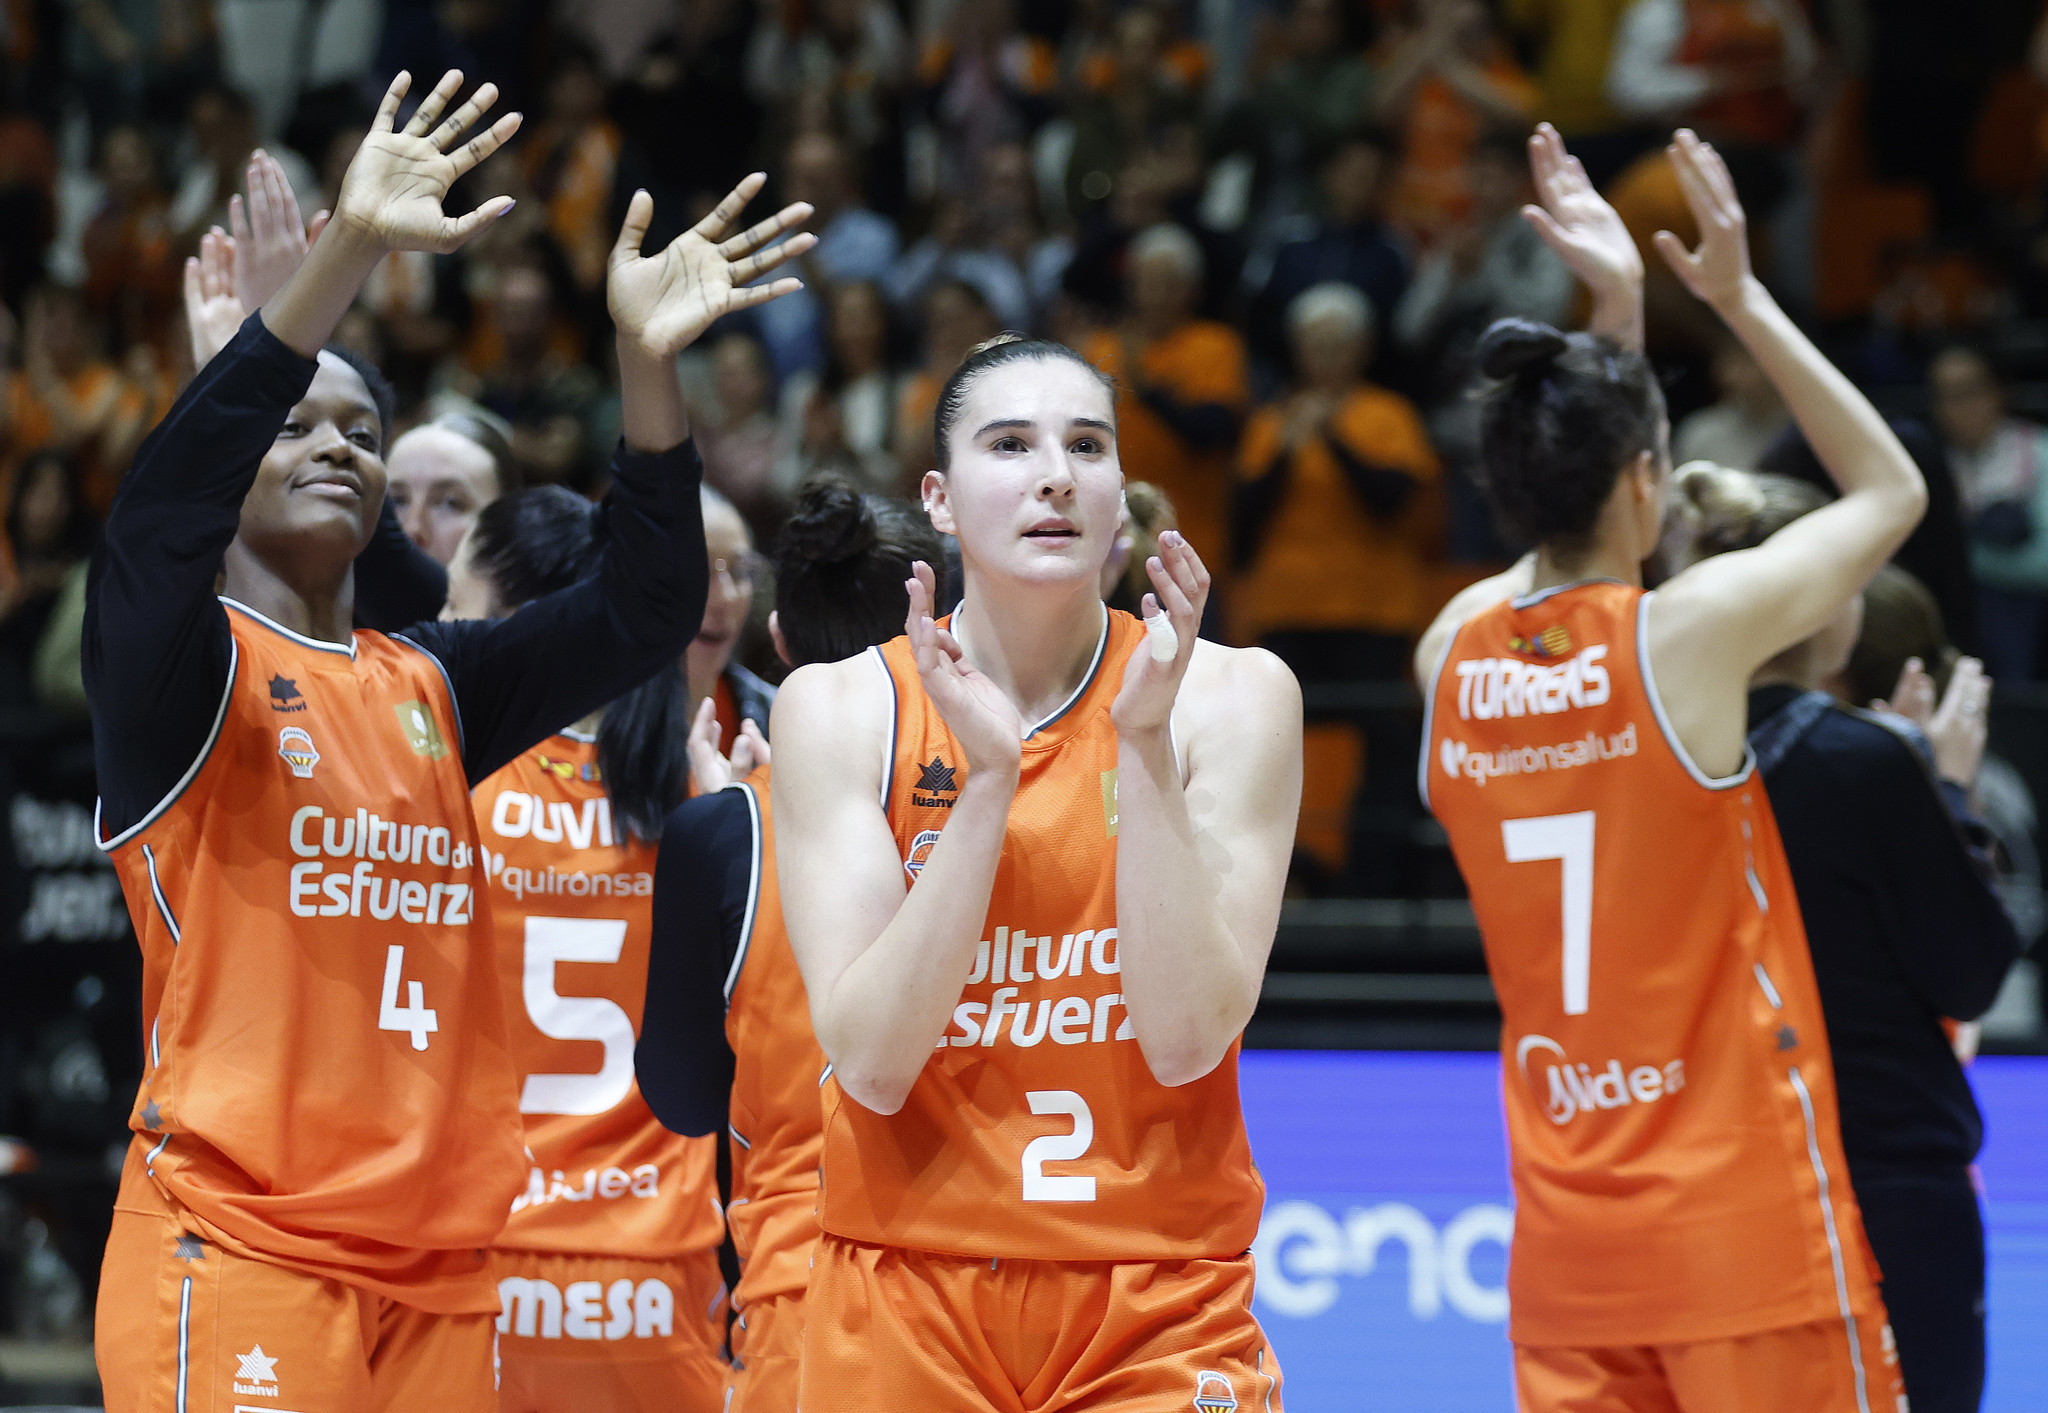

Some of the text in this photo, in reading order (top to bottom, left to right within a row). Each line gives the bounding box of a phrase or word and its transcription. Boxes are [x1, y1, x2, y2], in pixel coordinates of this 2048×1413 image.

[290, 805, 451, 867] Cultura
[492, 790, 614, 849] OUVI
[290, 861, 474, 925] Esfuerz
[502, 865, 653, 901] quirónsa
[1504, 812, 1596, 1015] 7
[965, 926, 1121, 985] ultura
[378, 945, 439, 1051] 4
[519, 916, 636, 1116] 5
[936, 987, 1137, 1048] sfuer
[1022, 1090, 1096, 1202] 2
[233, 1381, 279, 1398] luanvi
